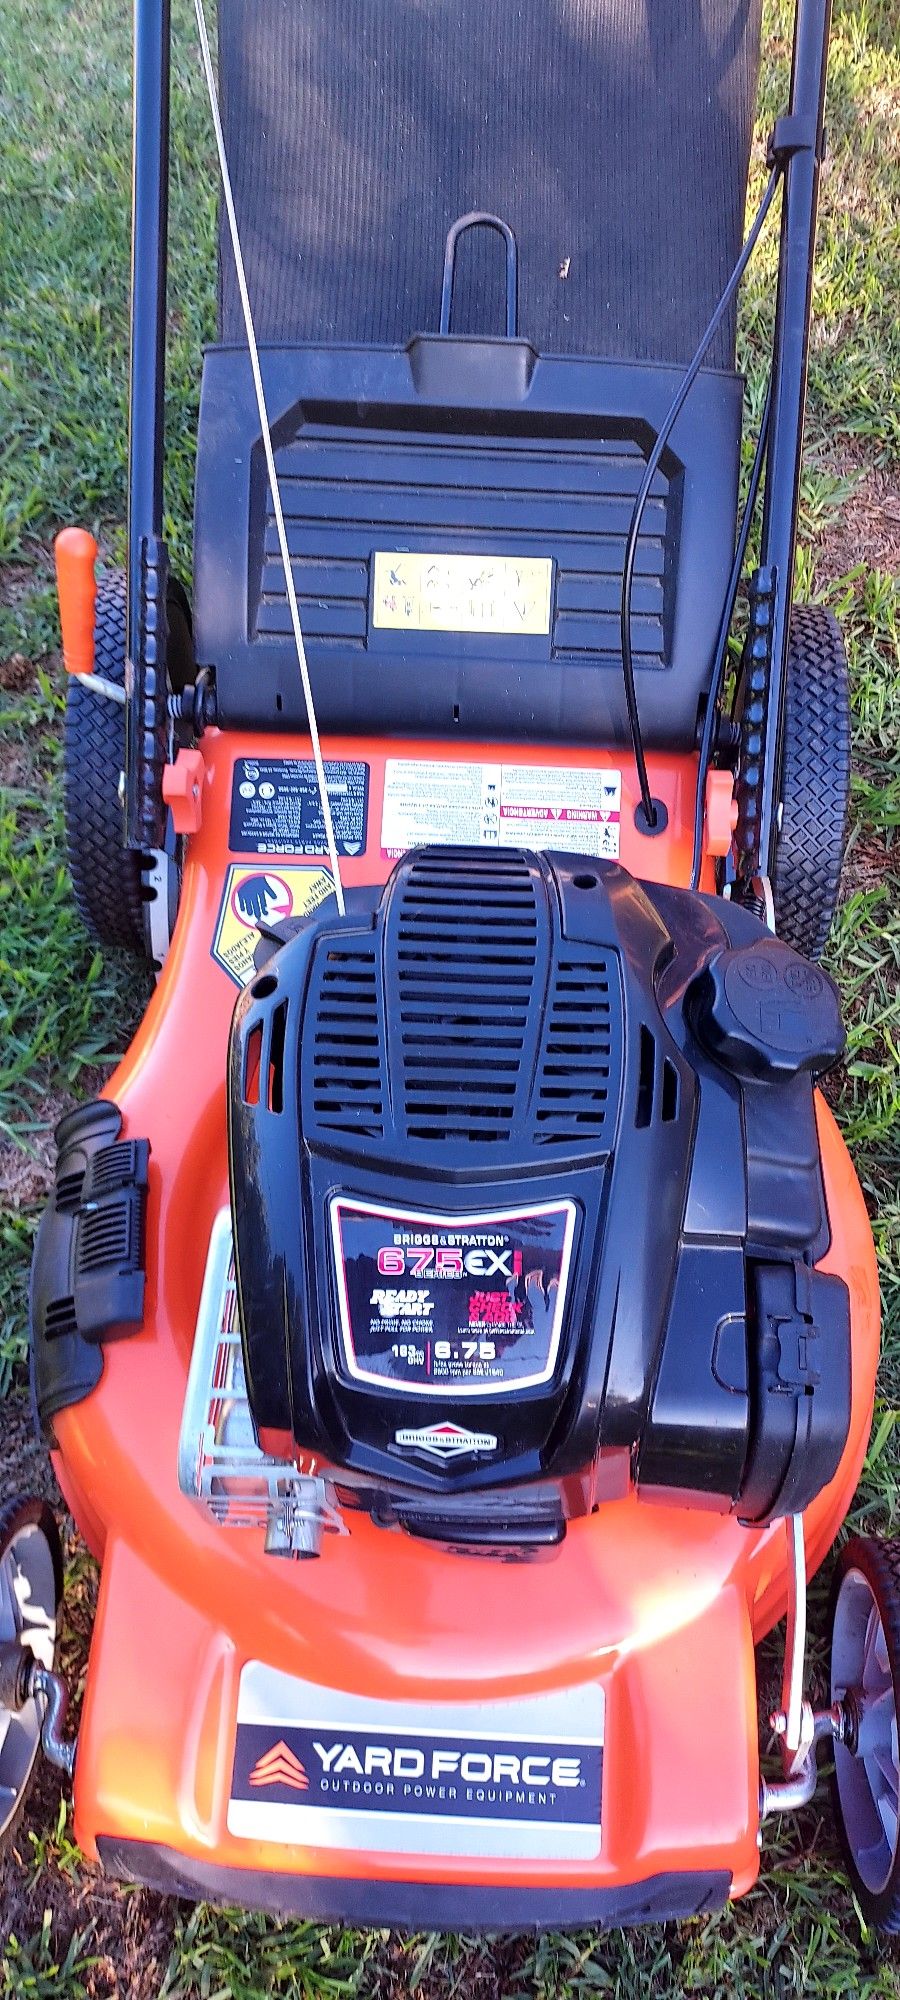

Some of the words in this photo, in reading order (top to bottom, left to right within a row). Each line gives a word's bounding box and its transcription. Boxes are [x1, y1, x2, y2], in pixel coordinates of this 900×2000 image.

[502, 806, 548, 818] ADVERTENCIA
[566, 809, 599, 821] WARNING
[257, 843, 304, 854] FORCE
[222, 932, 255, 958] ALEJADOS
[228, 951, 244, 964] PIES
[233, 955, 253, 971] ANOS
[370, 1289, 430, 1304] READY
[470, 1290, 509, 1302] JUST
[378, 1302, 435, 1317] START
[469, 1301, 524, 1313] CHECK
[312, 1742, 425, 1778] YARD
[320, 1777, 395, 1796] OUTDOOR
[403, 1782, 458, 1800] POWER
[466, 1787, 559, 1806] EQUIPMENT
